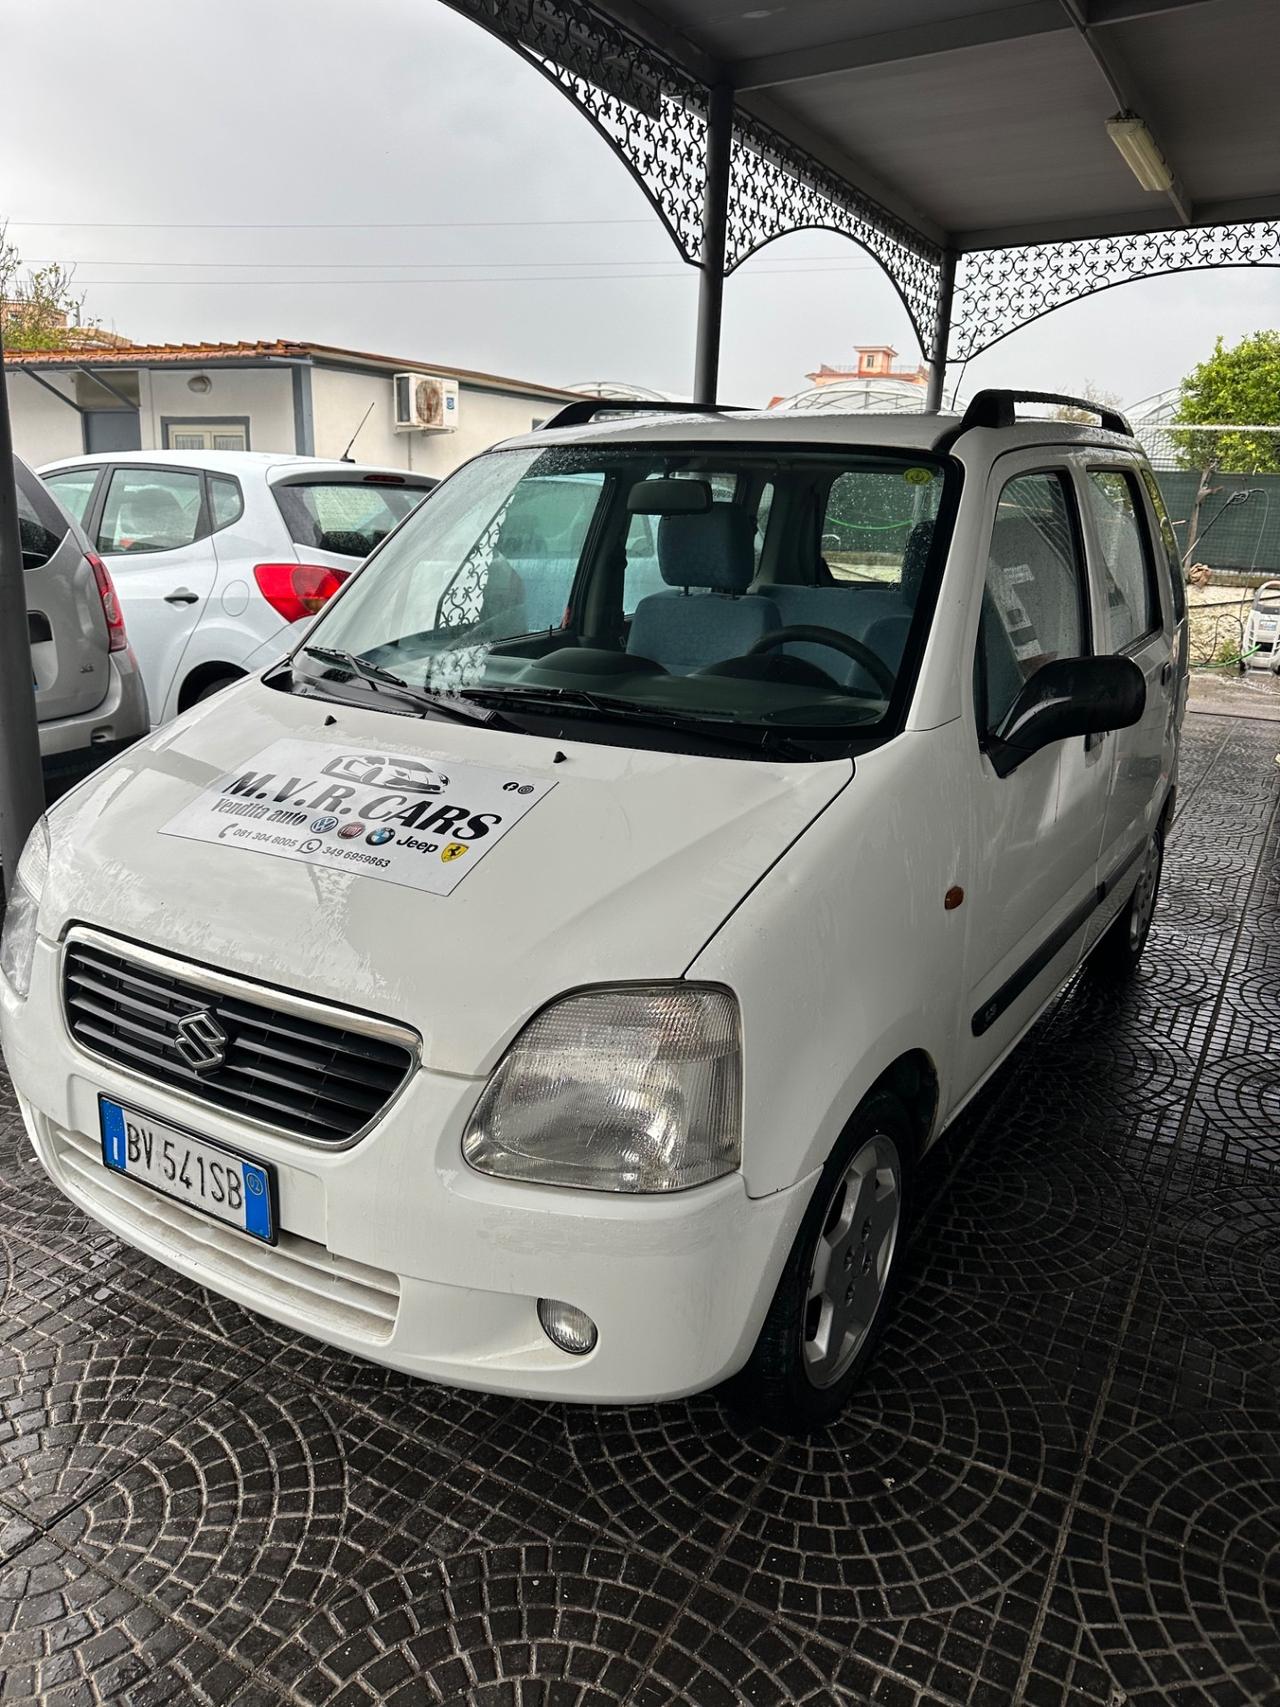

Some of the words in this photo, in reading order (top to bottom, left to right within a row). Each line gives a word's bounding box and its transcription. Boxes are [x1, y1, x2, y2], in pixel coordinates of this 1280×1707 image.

[211, 798, 270, 819] Vendita
[267, 809, 308, 826] auto
[233, 828, 252, 839] 081
[252, 832, 271, 843] 304
[271, 835, 299, 848] 8005
[396, 835, 440, 854] Jeep
[322, 846, 344, 857] 349
[343, 851, 391, 868] 6959863
[127, 1123, 153, 1170] BV
